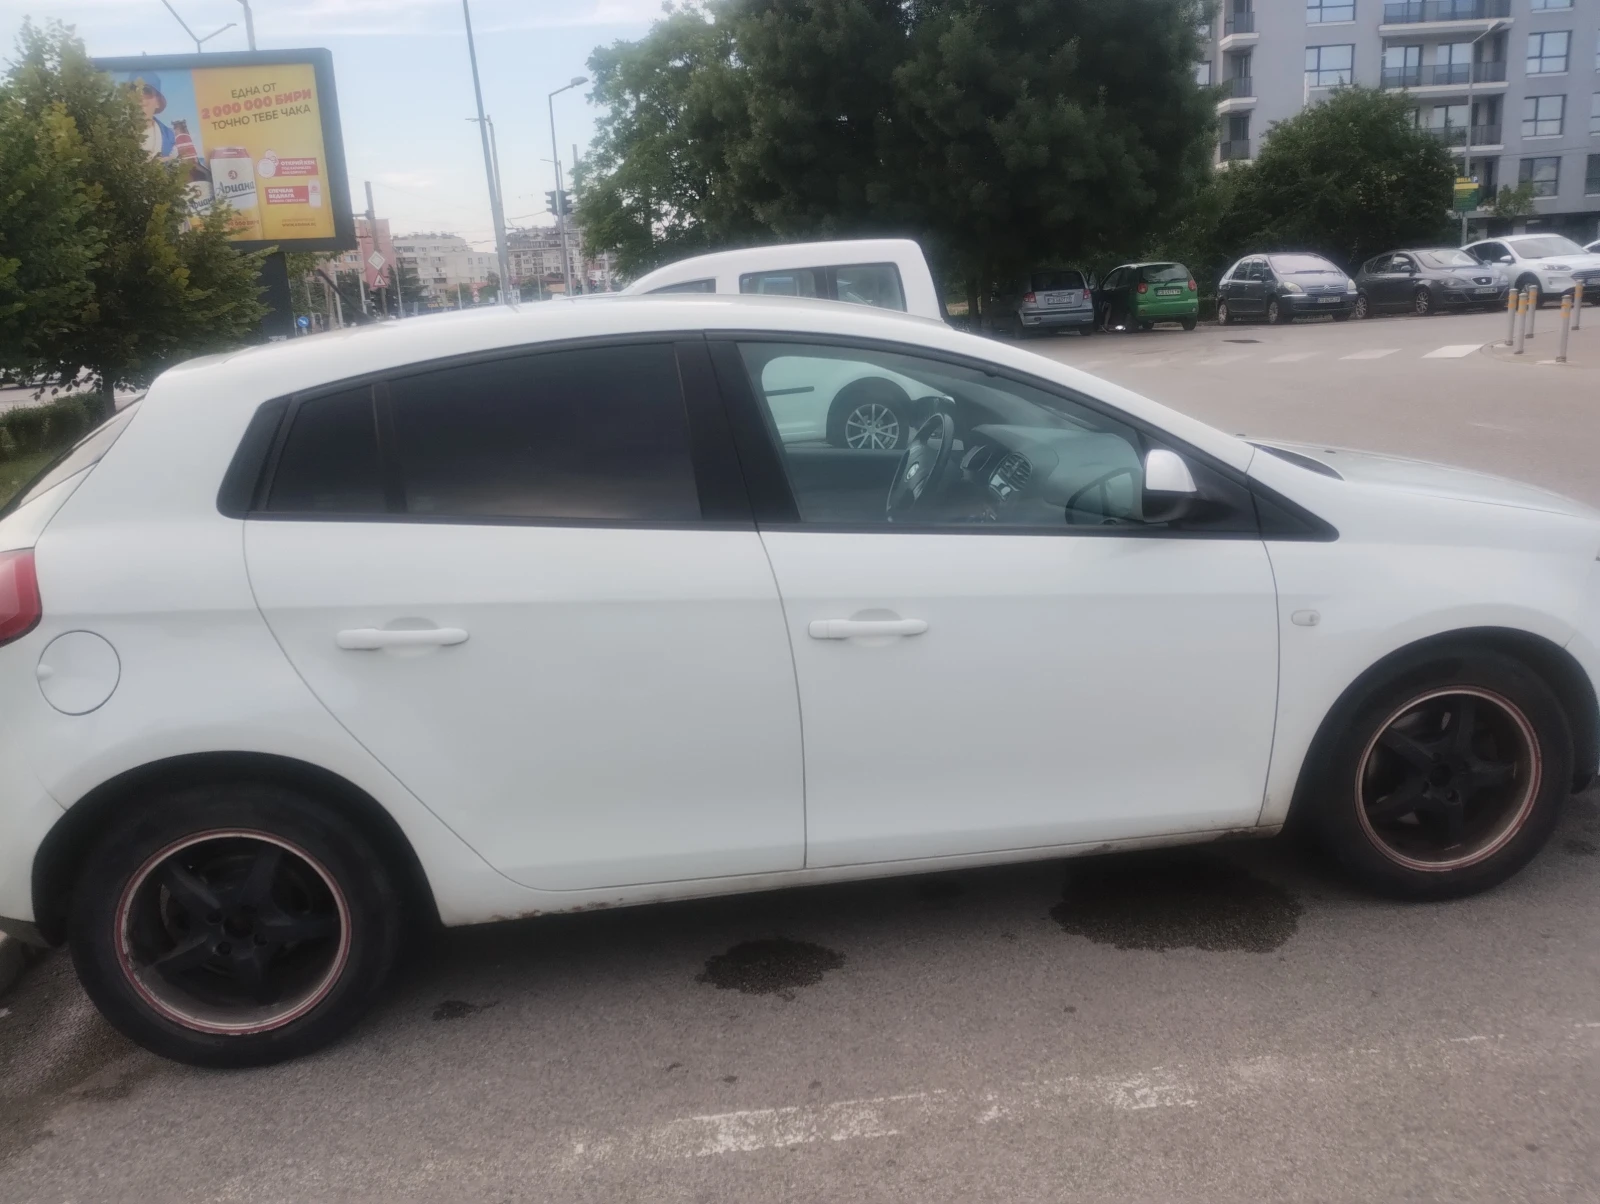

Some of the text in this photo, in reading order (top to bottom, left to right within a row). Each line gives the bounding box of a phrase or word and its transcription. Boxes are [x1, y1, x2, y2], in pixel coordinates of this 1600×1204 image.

[231, 83, 276, 99] ЕДНА ОТ
[201, 89, 312, 119] 2 000 000 БИРИ
[211, 104, 311, 130] ТОЧНО ТЕБЕ ЧАКА
[215, 181, 255, 197] Ариана
